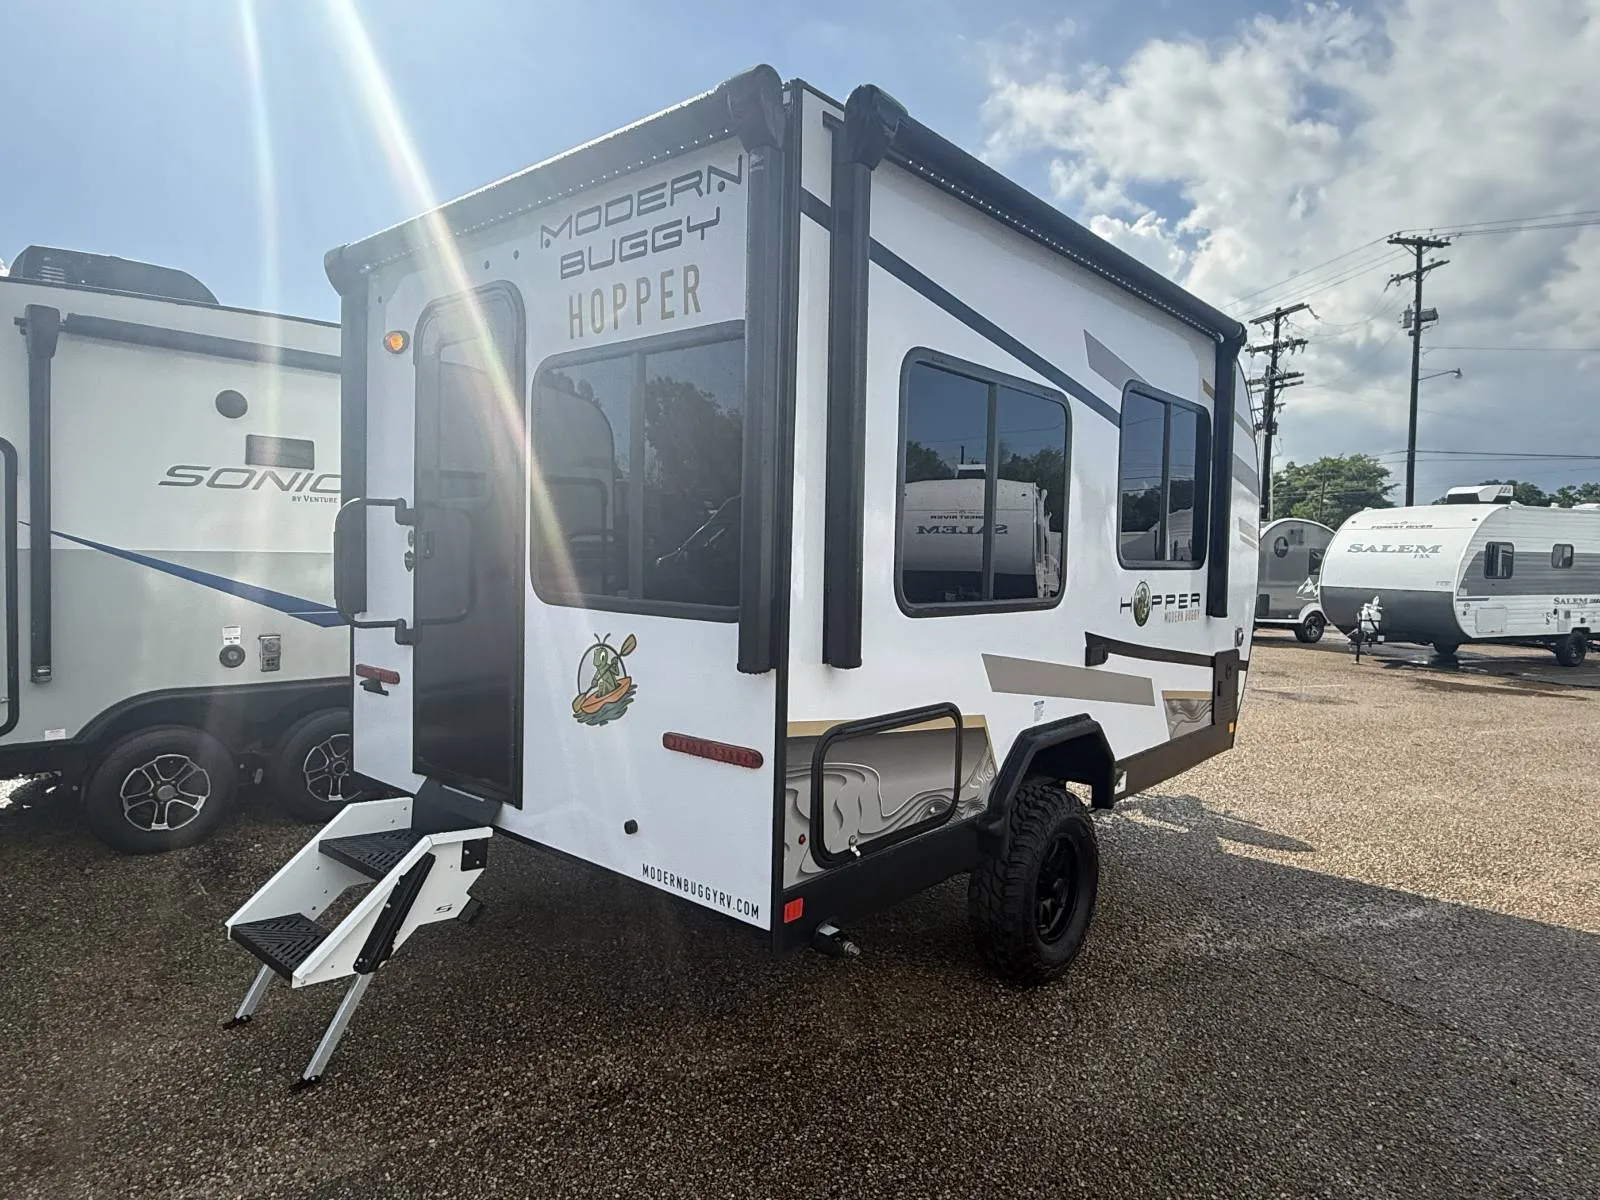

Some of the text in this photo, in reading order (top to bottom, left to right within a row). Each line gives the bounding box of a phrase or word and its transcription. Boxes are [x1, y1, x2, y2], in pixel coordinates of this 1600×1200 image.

[540, 154, 742, 250] MODERN
[560, 206, 720, 280] BUGGY
[568, 264, 702, 340] HOPPER
[158, 464, 341, 493] SONIC
[1347, 543, 1442, 554] SALEM
[642, 863, 759, 920] MODERNBUGGYRV.COM
